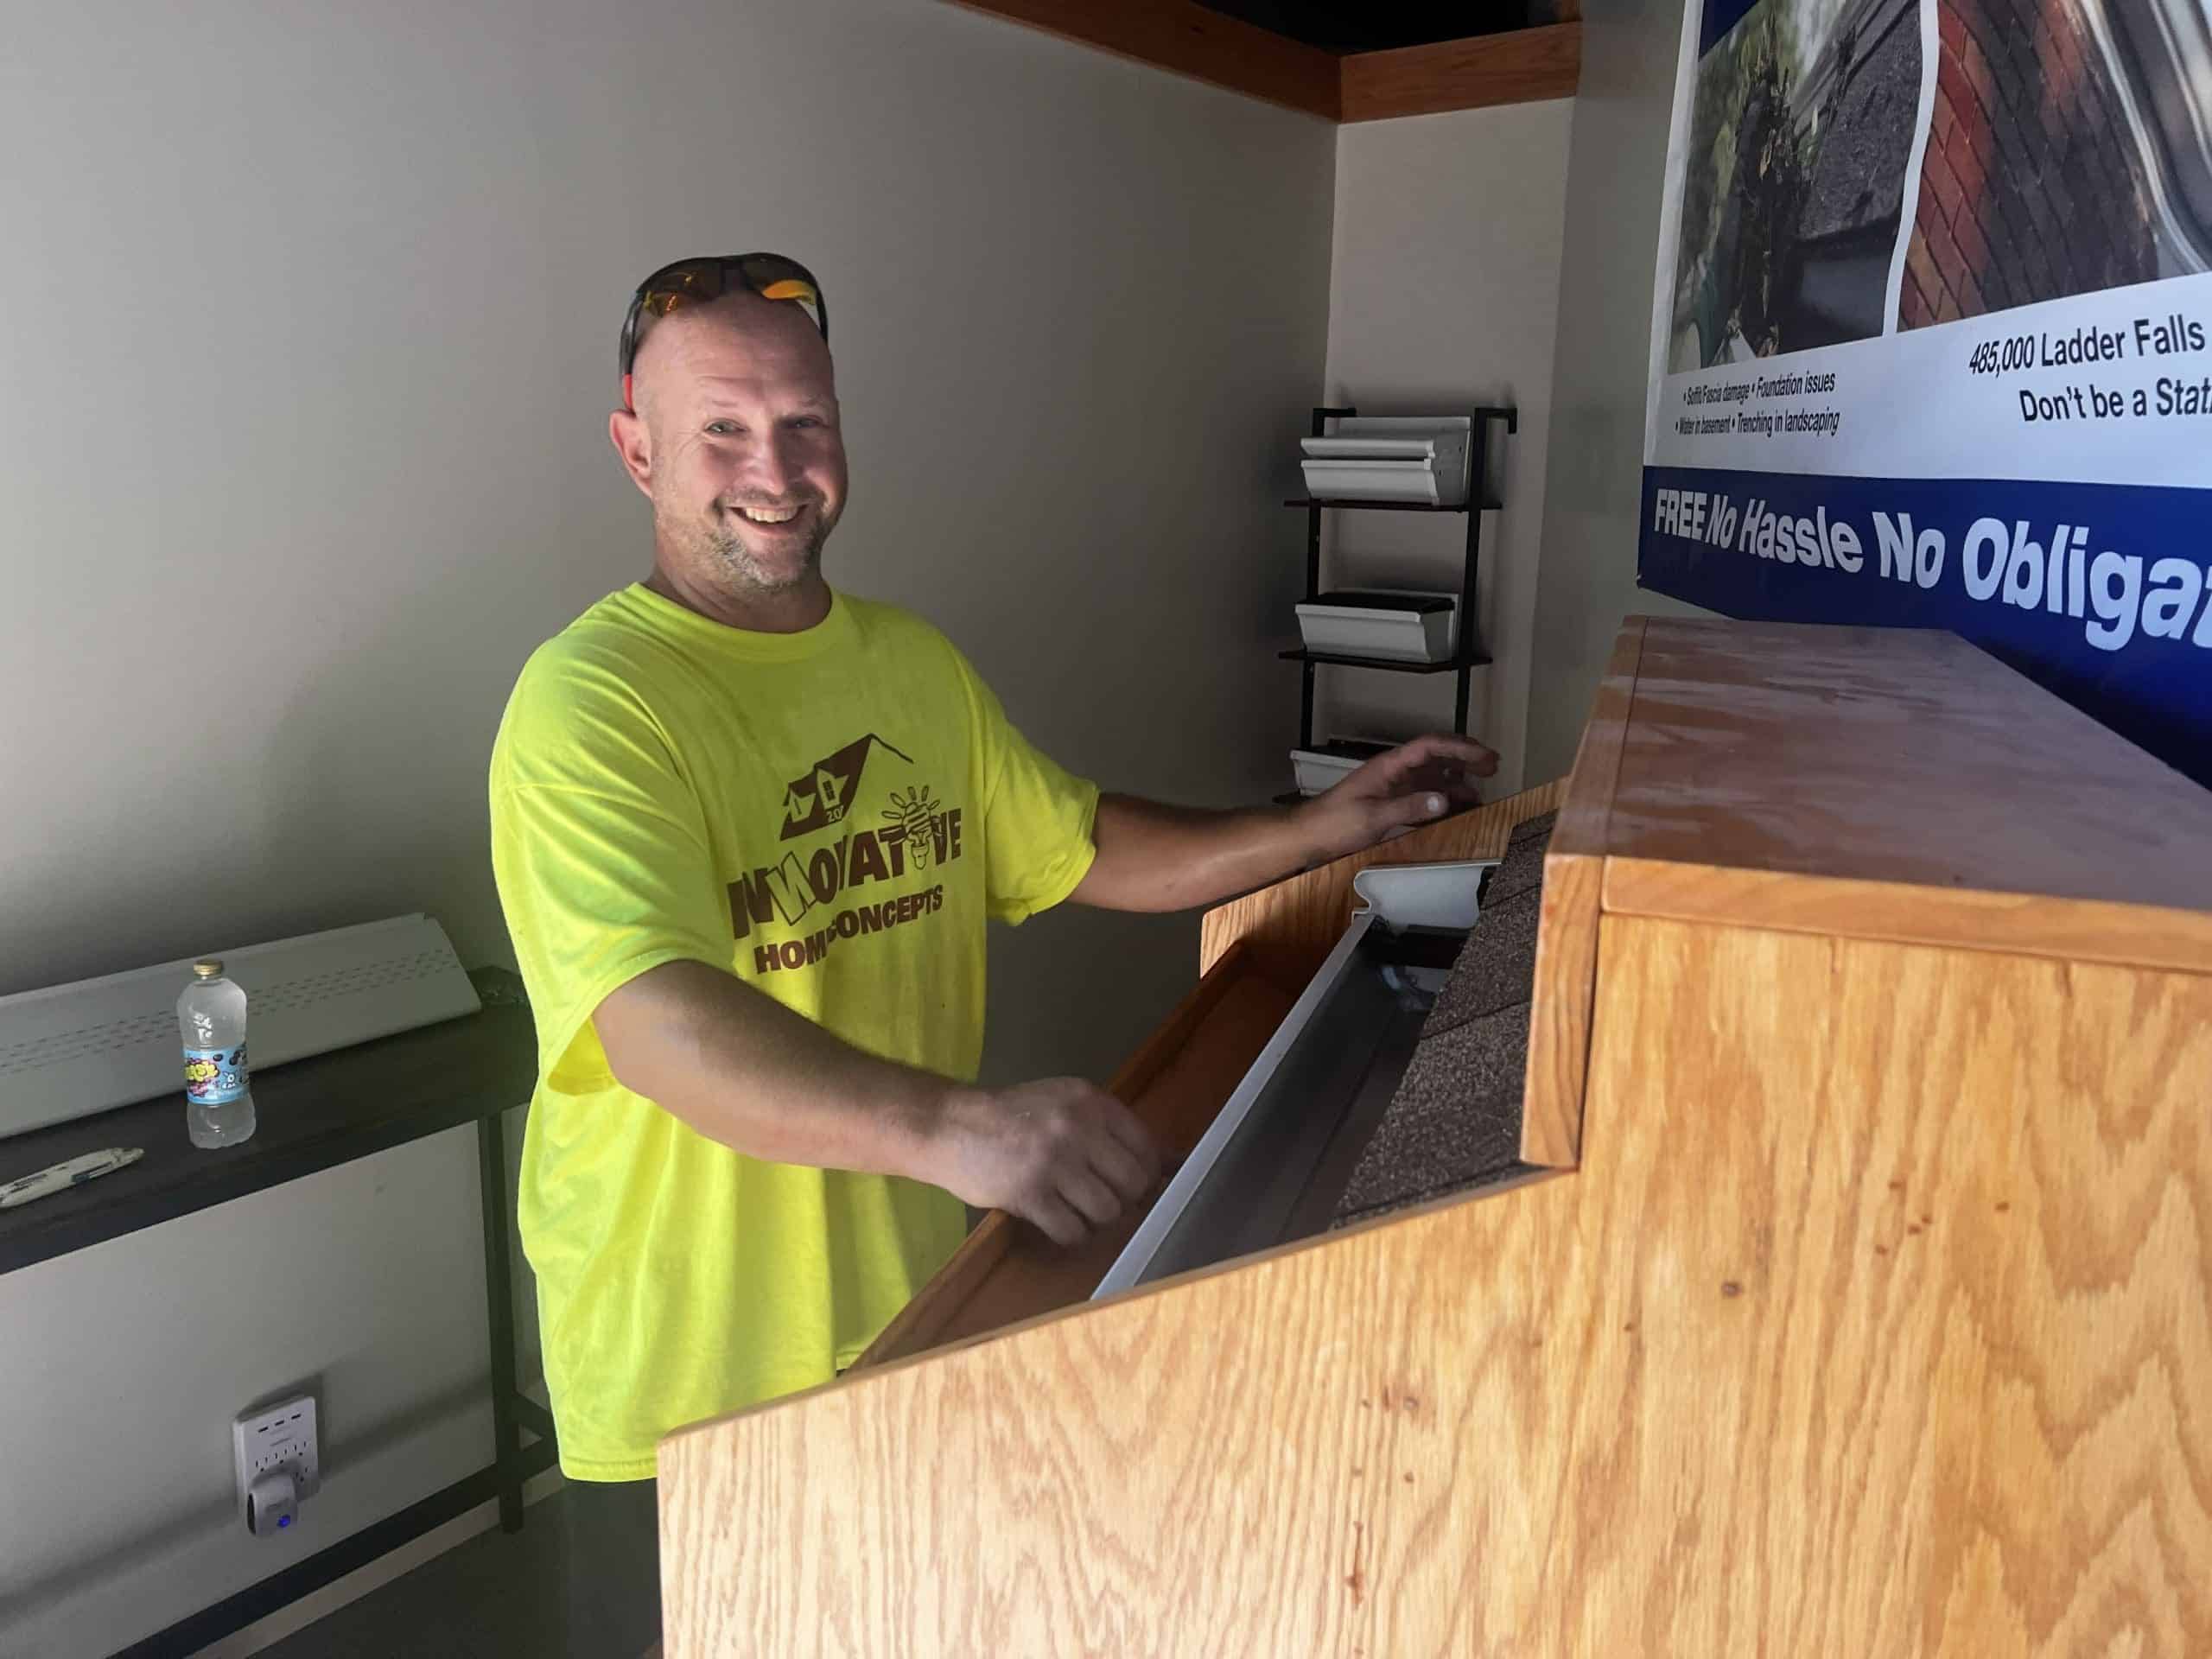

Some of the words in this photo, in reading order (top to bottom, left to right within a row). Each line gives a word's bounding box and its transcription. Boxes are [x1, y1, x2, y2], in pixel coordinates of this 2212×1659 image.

[1968, 334, 2035, 378] 485,000
[2041, 326, 2126, 366] Ladder
[2133, 314, 2205, 356] Falls
[1722, 381, 1750, 404] damage
[1756, 372, 1802, 398] Foundation
[1804, 370, 1836, 394] issues
[2019, 386, 2087, 422] Don't
[2089, 384, 2124, 417] be
[2133, 389, 2147, 416] a
[2156, 378, 2212, 416] Stat
[1700, 414, 1731, 435] basement
[1737, 409, 1772, 437] Trenching
[1774, 409, 1783, 432] in
[1784, 406, 1840, 436] landscaping
[1654, 488, 1707, 543] FREE
[1705, 493, 1738, 550] No
[1738, 498, 1864, 574] Hassle
[1872, 511, 1945, 588] No
[753, 931, 830, 975] HOM
